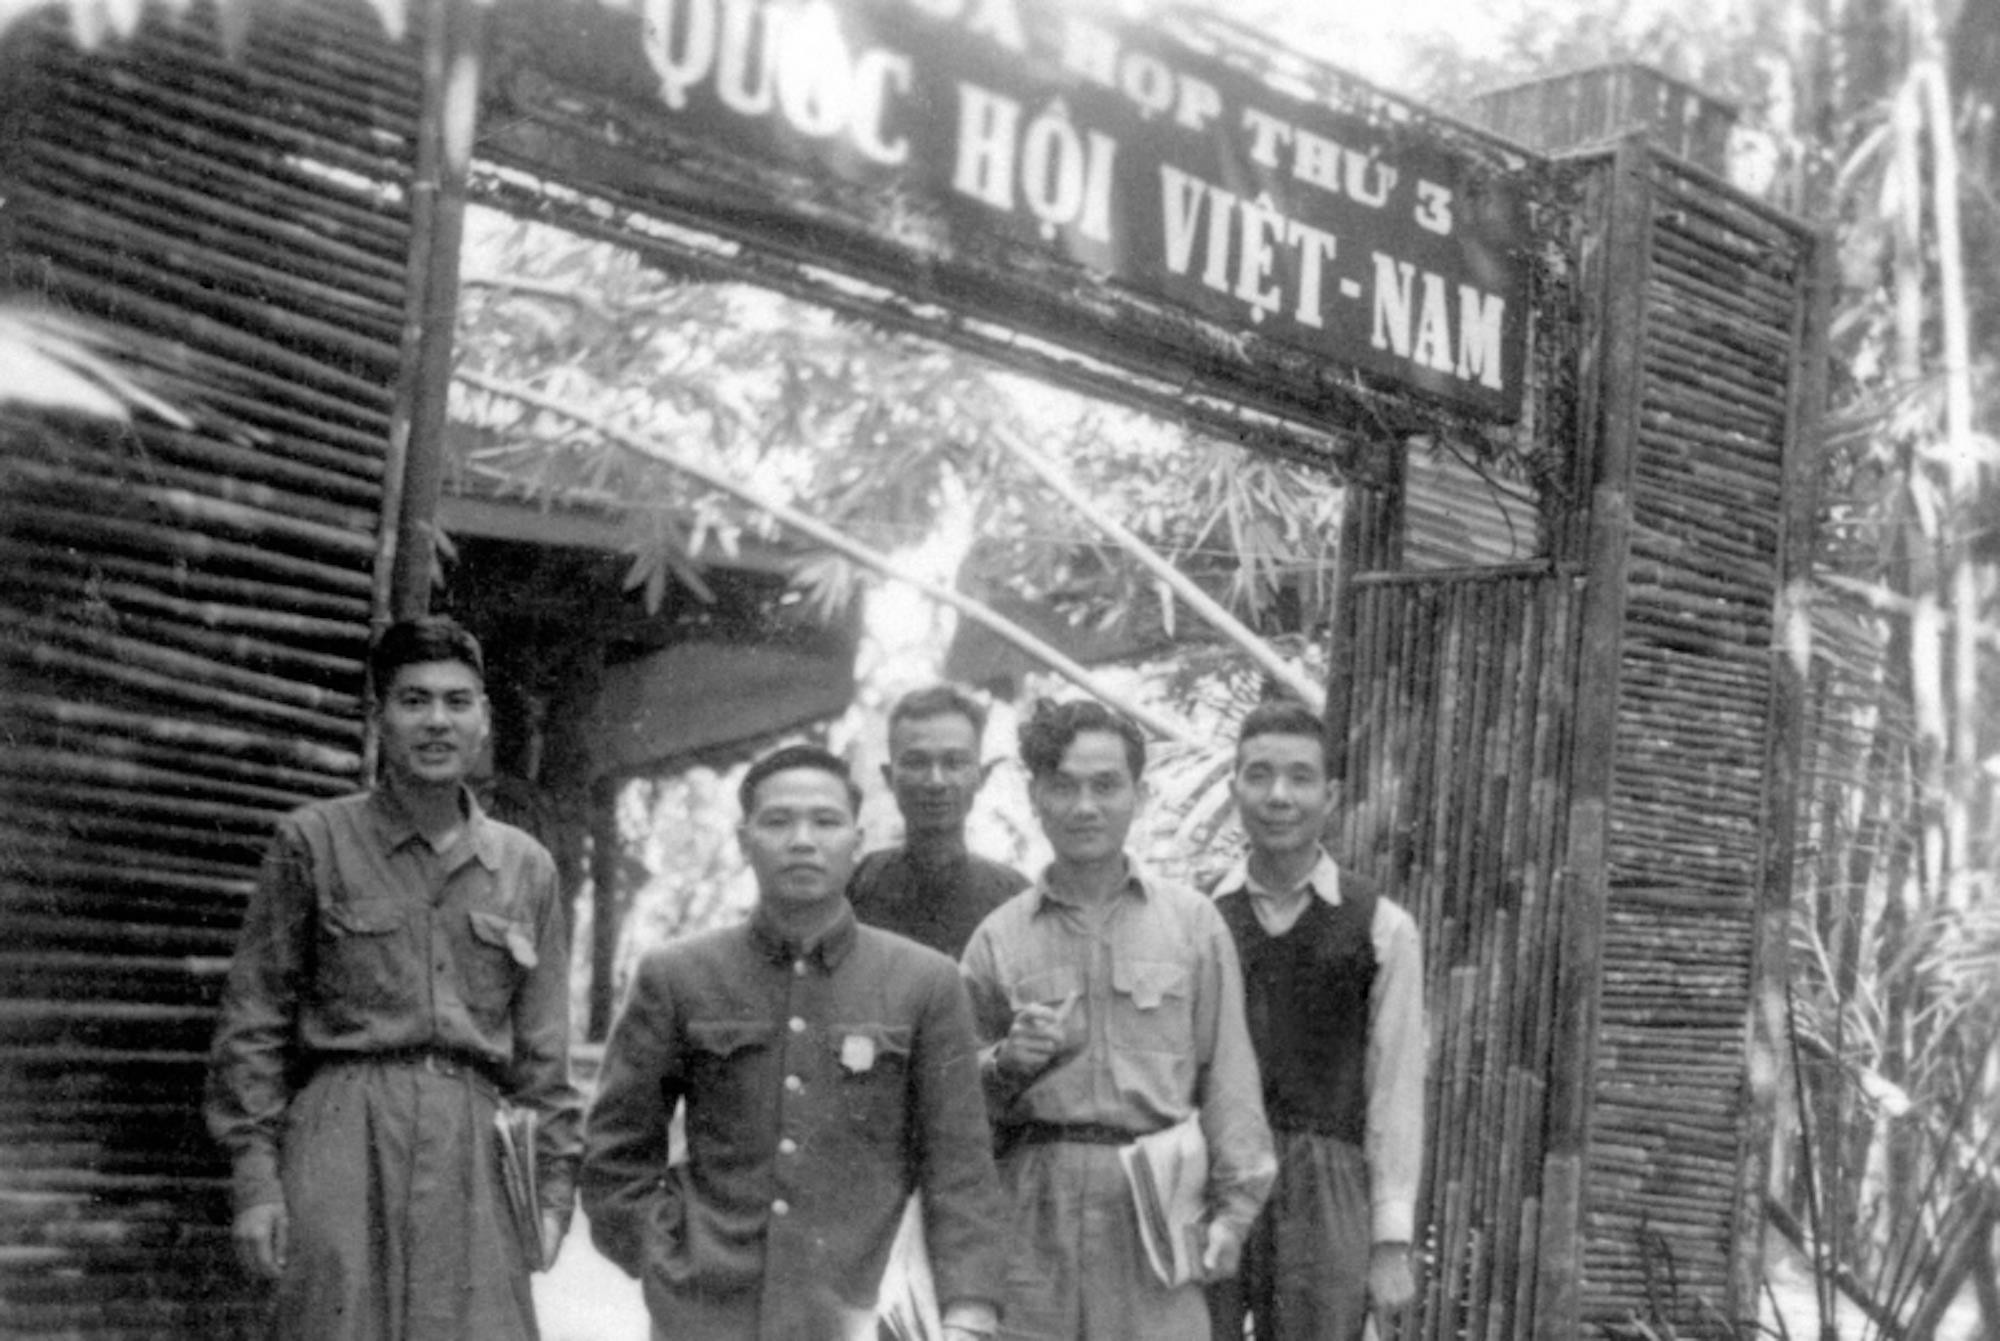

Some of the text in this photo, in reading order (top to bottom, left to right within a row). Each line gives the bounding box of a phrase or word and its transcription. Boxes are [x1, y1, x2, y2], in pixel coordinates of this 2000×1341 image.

[954, 80, 1116, 243] HỘI
[1242, 107, 1399, 209] THỨ
[1415, 178, 1453, 236] 3
